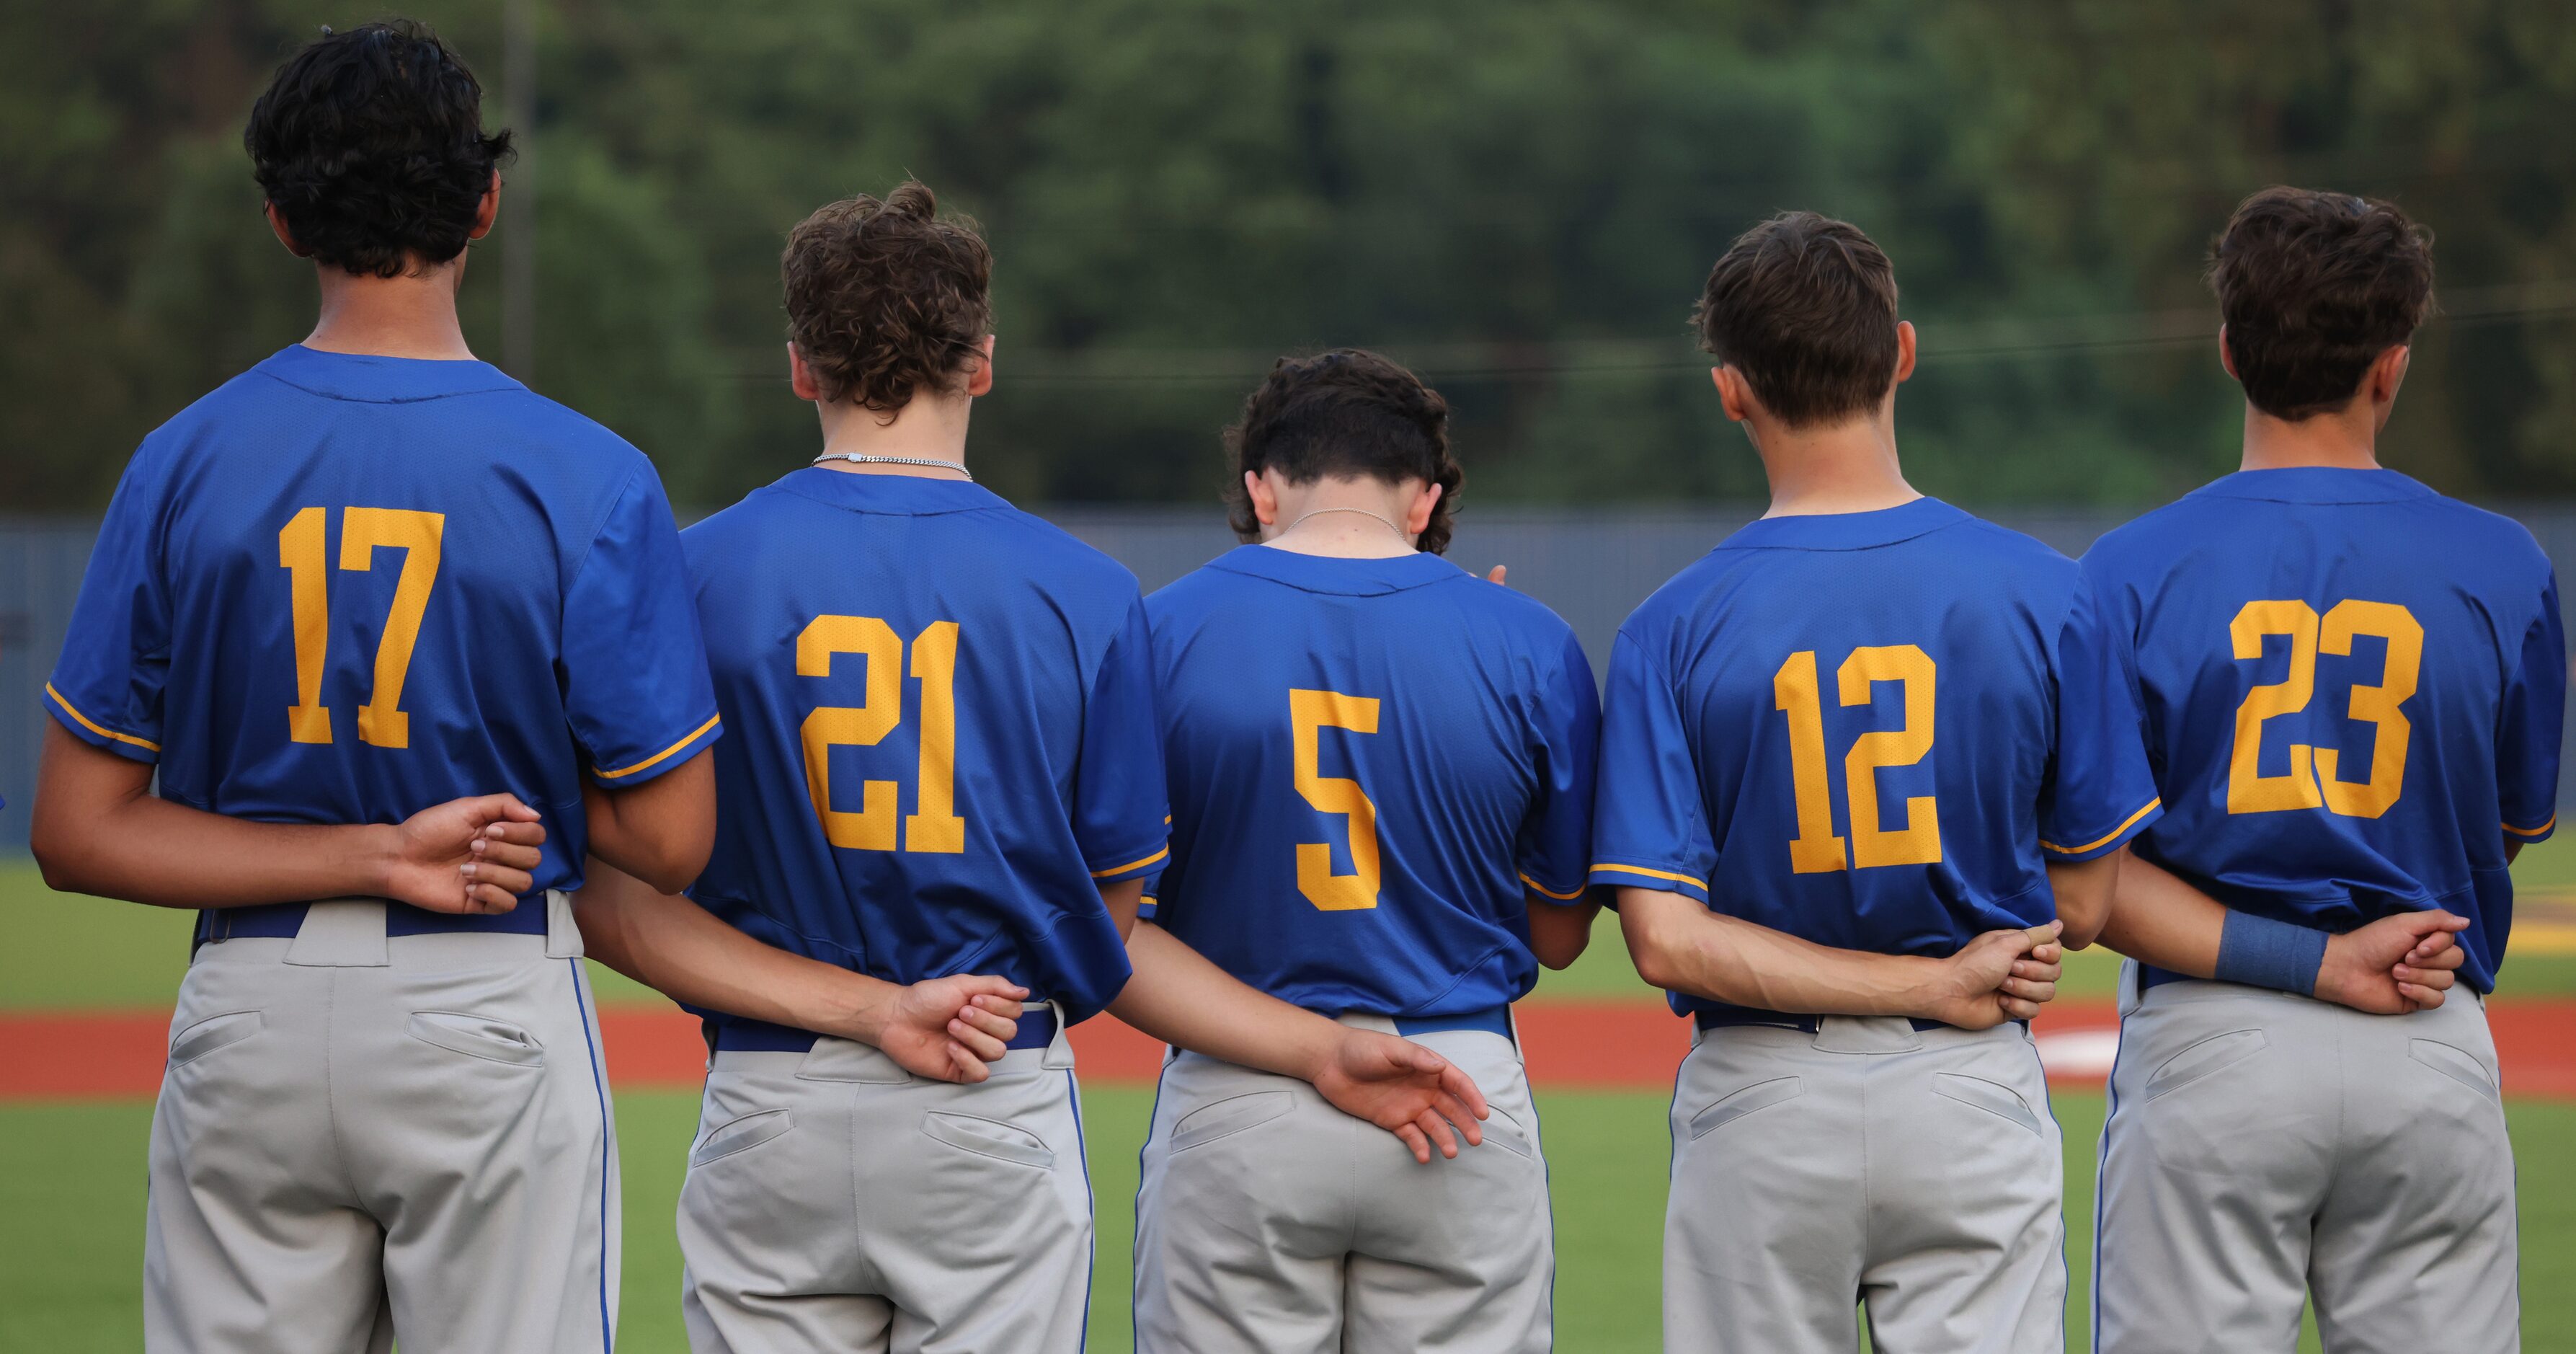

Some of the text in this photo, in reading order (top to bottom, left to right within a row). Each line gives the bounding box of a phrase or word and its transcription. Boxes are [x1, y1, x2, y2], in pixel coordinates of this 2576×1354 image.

[279, 507, 445, 748] 17
[796, 615, 965, 854] 21
[2227, 599, 2424, 819] 23
[1289, 689, 1380, 911] 5
[1773, 645, 1942, 874] 12
